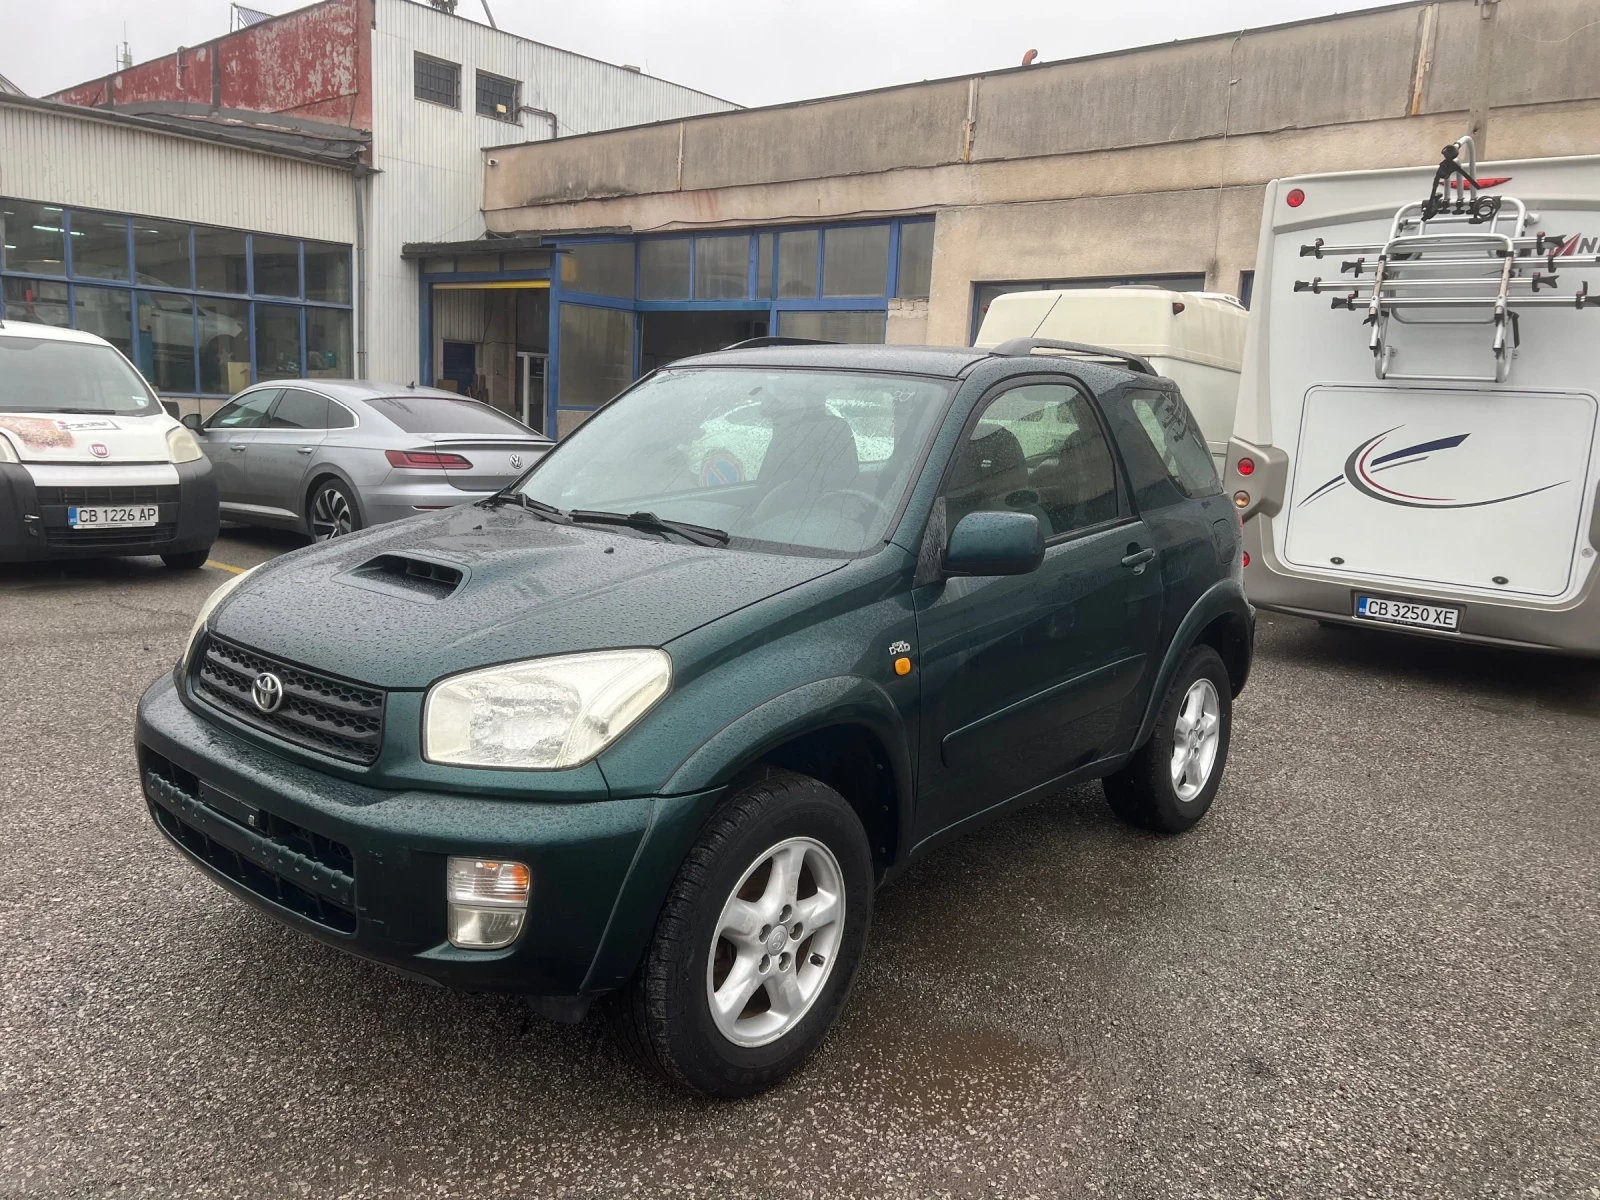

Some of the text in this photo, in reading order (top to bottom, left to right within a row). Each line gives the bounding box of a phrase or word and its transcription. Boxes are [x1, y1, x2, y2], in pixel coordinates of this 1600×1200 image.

[79, 507, 156, 523] CB 1226 AP
[1368, 600, 1388, 616] CB
[1391, 603, 1430, 621] 3250
[1433, 608, 1455, 626] XE
